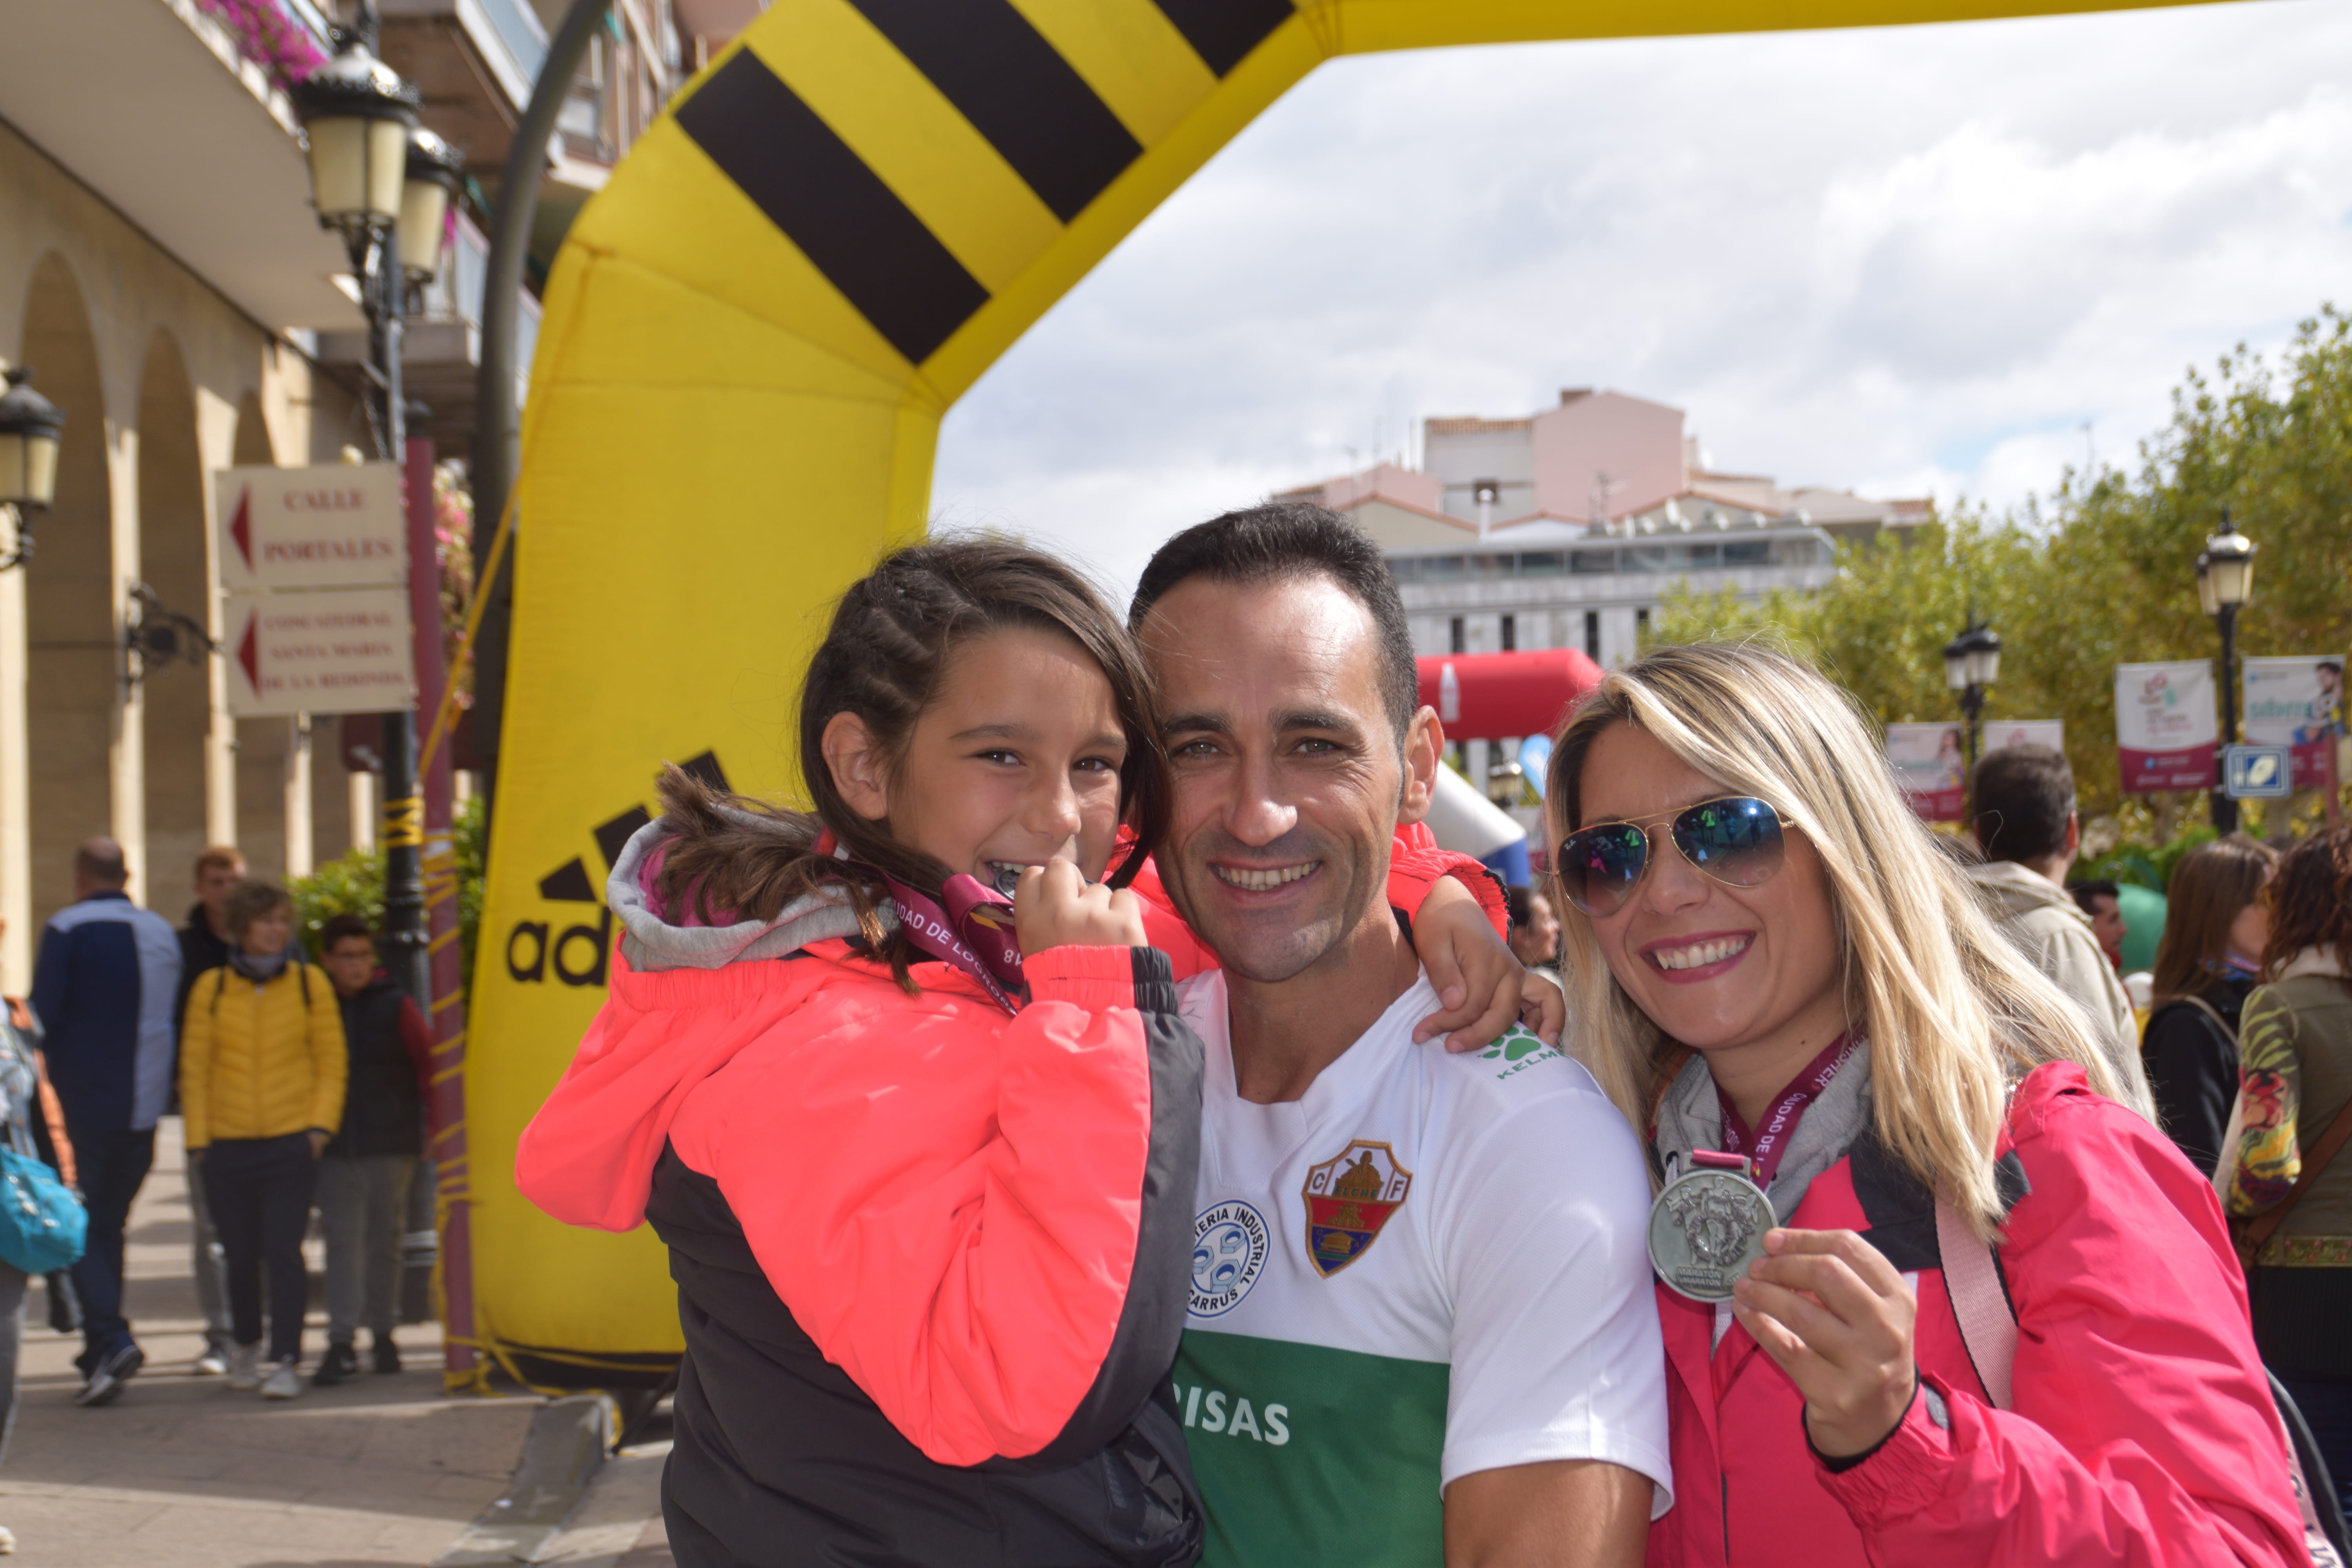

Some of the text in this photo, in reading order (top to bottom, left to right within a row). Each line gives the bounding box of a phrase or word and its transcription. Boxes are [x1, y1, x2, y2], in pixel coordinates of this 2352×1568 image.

[282, 488, 367, 512] CALLE
[263, 537, 394, 563] PORTALES
[506, 906, 611, 986] ad
[926, 922, 951, 944] DE
[1497, 1050, 1566, 1080] KELM
[1756, 1093, 1806, 1153] CIUDAD DE
[1312, 1172, 1404, 1199] C F
[1334, 1186, 1377, 1199] ELCHE
[1194, 1207, 1265, 1285] TERIA INDUSTRIAL
